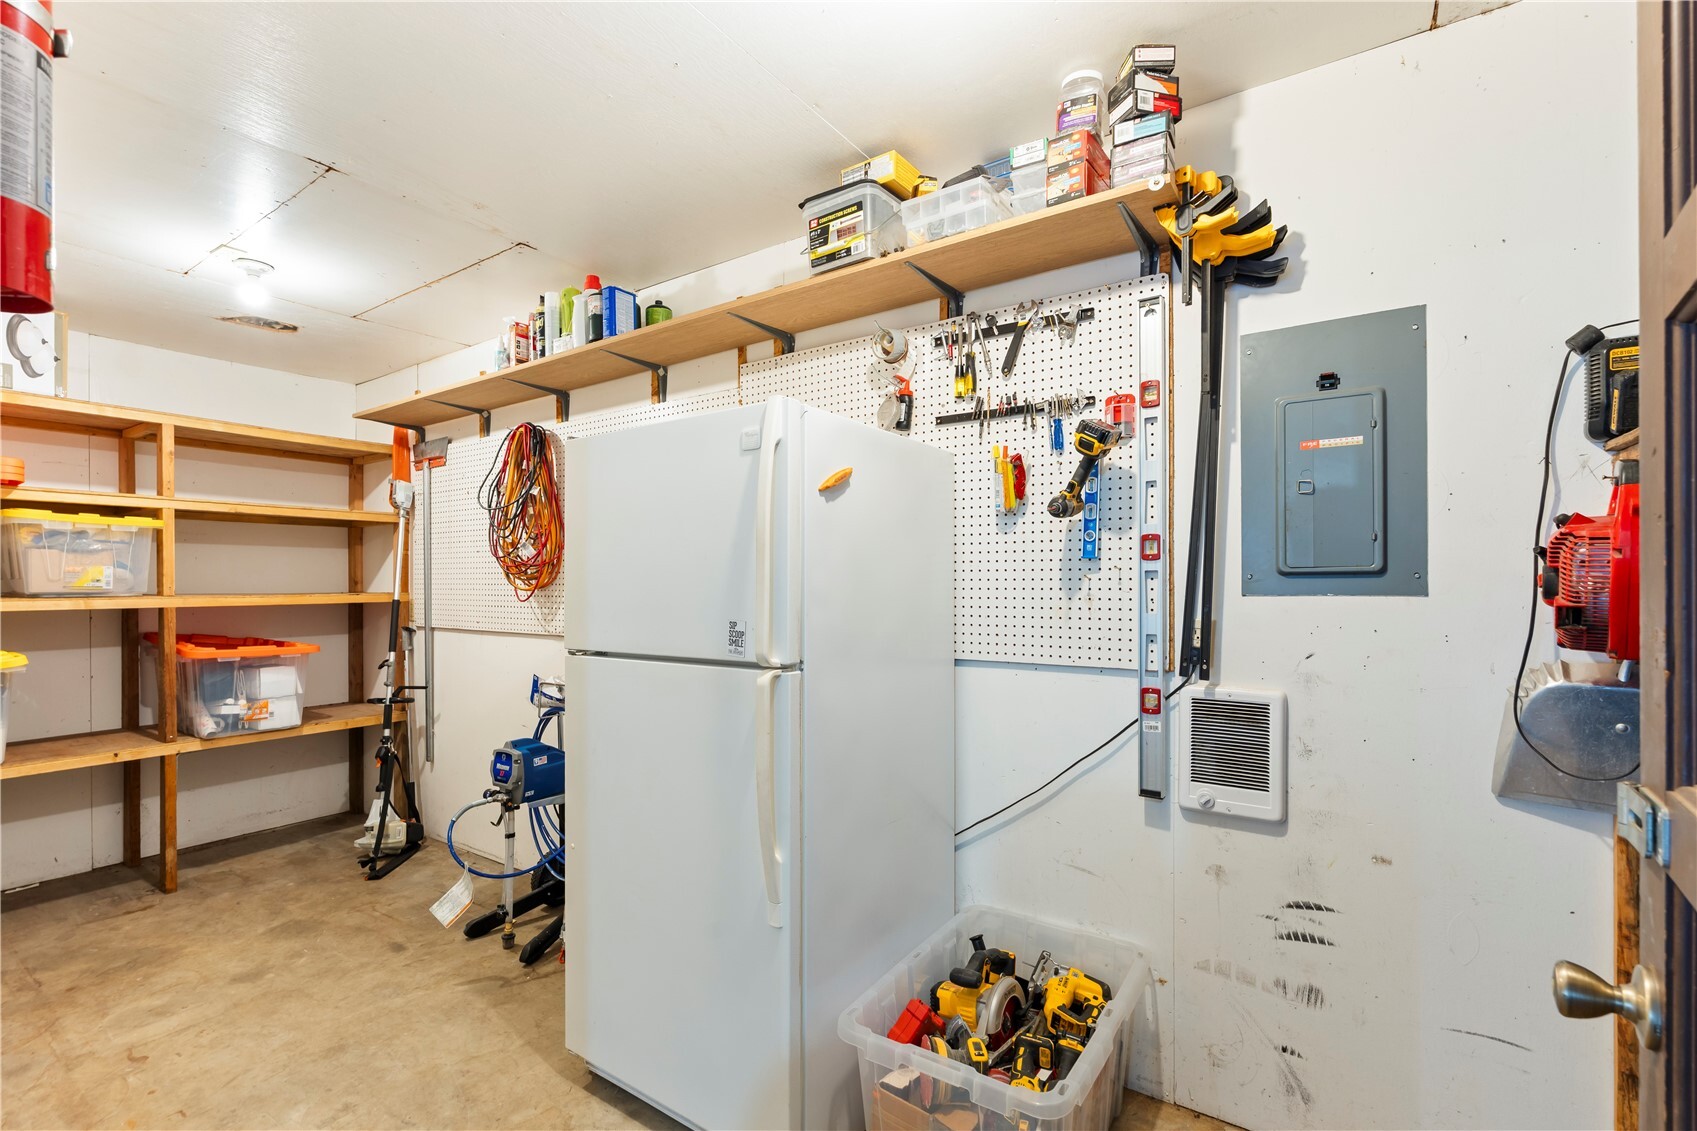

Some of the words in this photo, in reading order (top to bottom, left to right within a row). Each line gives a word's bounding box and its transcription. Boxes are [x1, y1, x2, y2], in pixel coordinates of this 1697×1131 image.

[819, 210, 843, 224] CONSTRUCTION
[844, 205, 858, 215] SCREWS
[728, 621, 737, 629] SIP
[728, 630, 745, 639] SCOOP
[728, 638, 744, 648] SMILE
